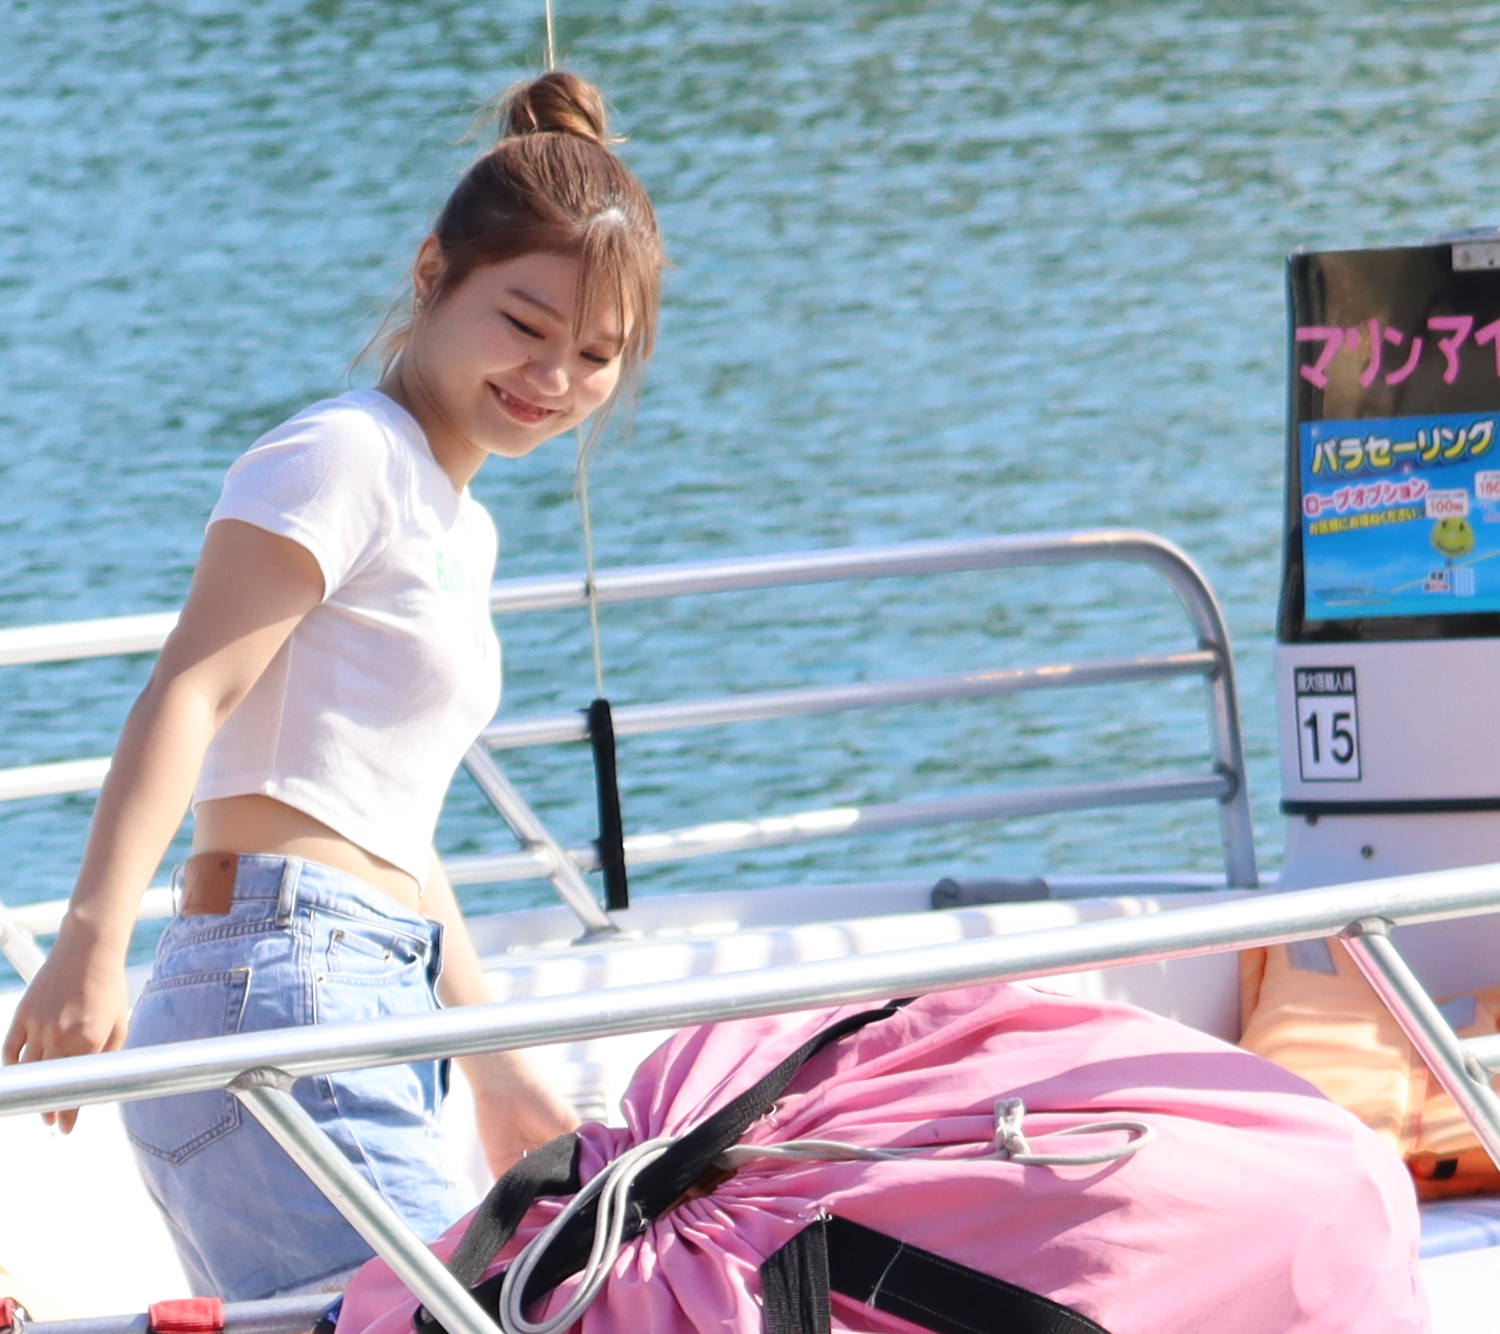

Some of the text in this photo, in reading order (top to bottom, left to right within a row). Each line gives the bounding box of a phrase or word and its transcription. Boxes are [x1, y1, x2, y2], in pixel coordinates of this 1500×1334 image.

[1311, 419, 1496, 474] パラセーリング
[1304, 479, 1428, 515] ロープオプション
[1430, 500, 1464, 514] 100m
[1304, 712, 1354, 764] 15
